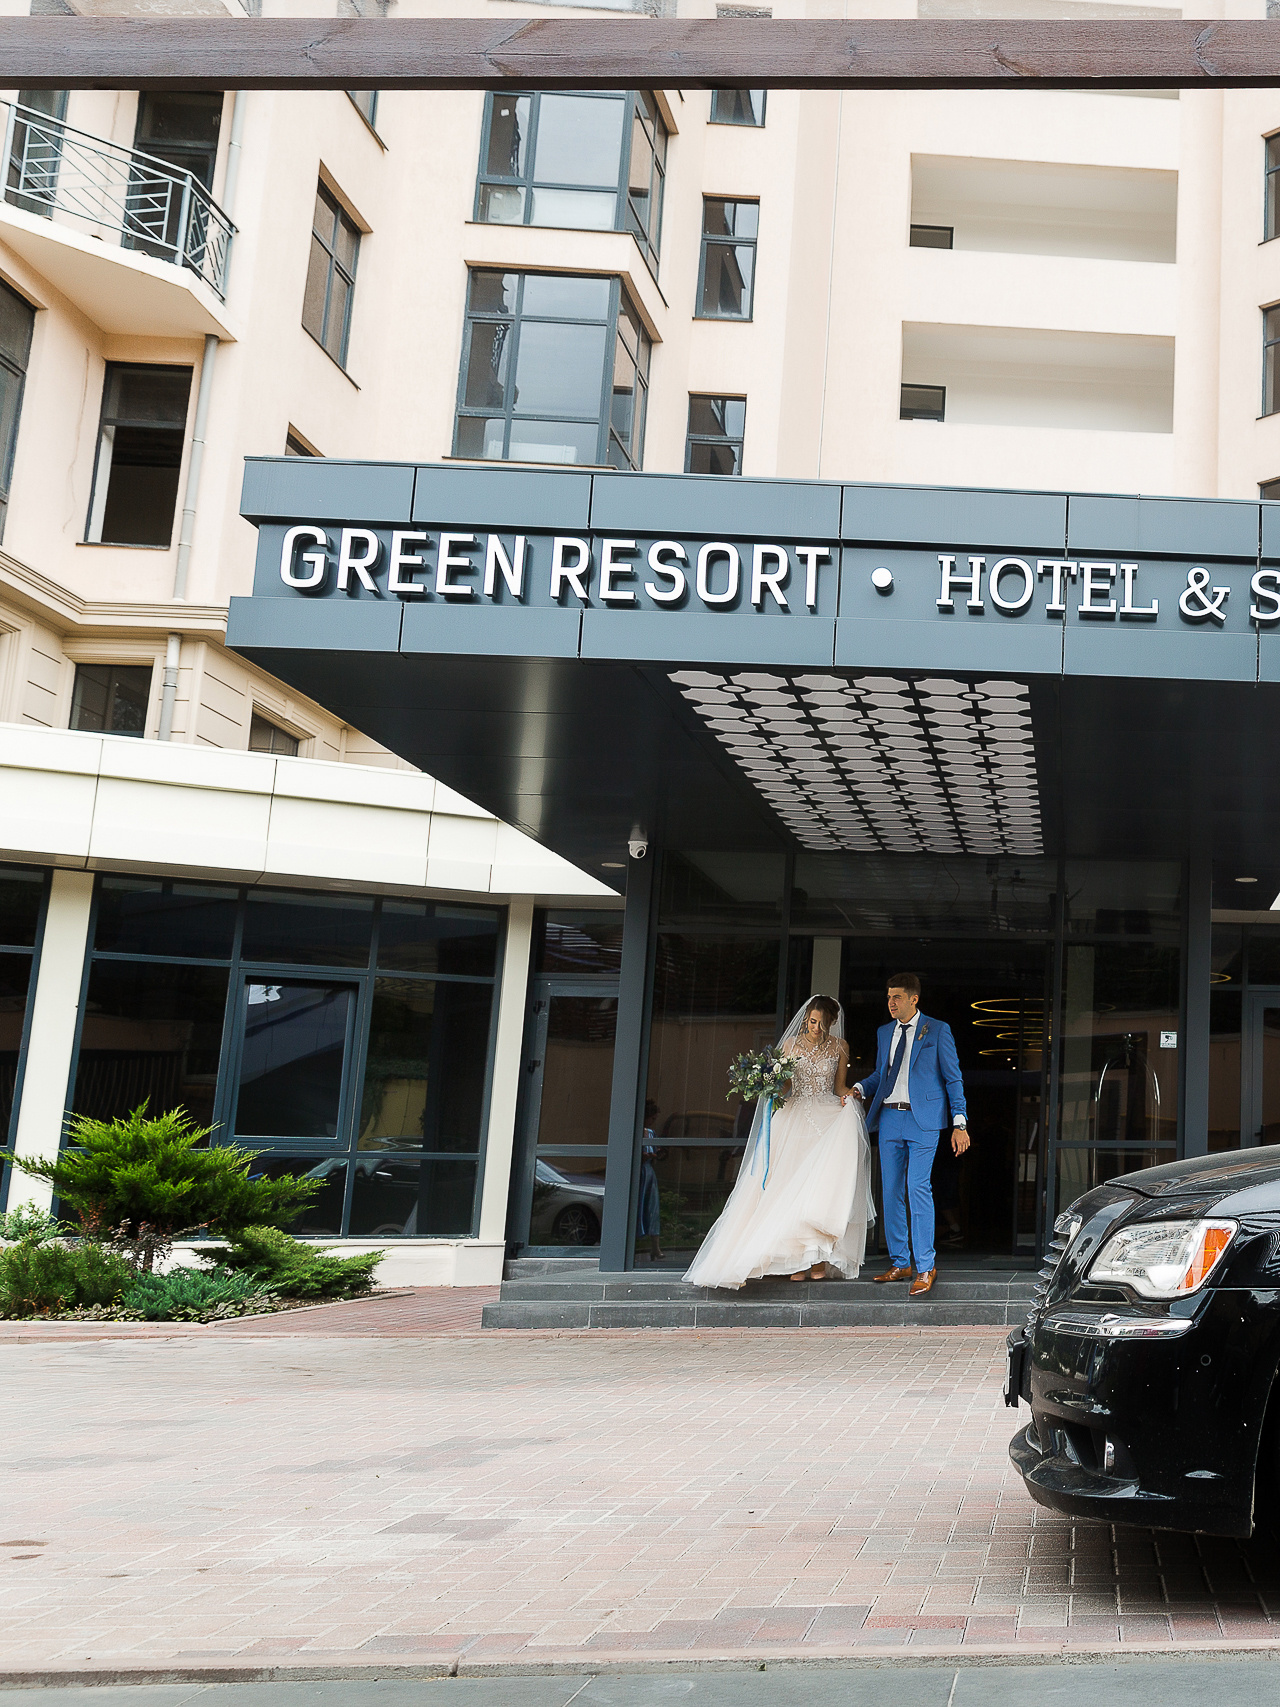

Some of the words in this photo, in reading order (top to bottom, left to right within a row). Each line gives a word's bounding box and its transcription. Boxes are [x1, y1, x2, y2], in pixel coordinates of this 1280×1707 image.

[280, 525, 527, 597] GREEN
[549, 536, 830, 606] RESORT
[935, 554, 1159, 614] HOTEL
[1178, 567, 1231, 620] &
